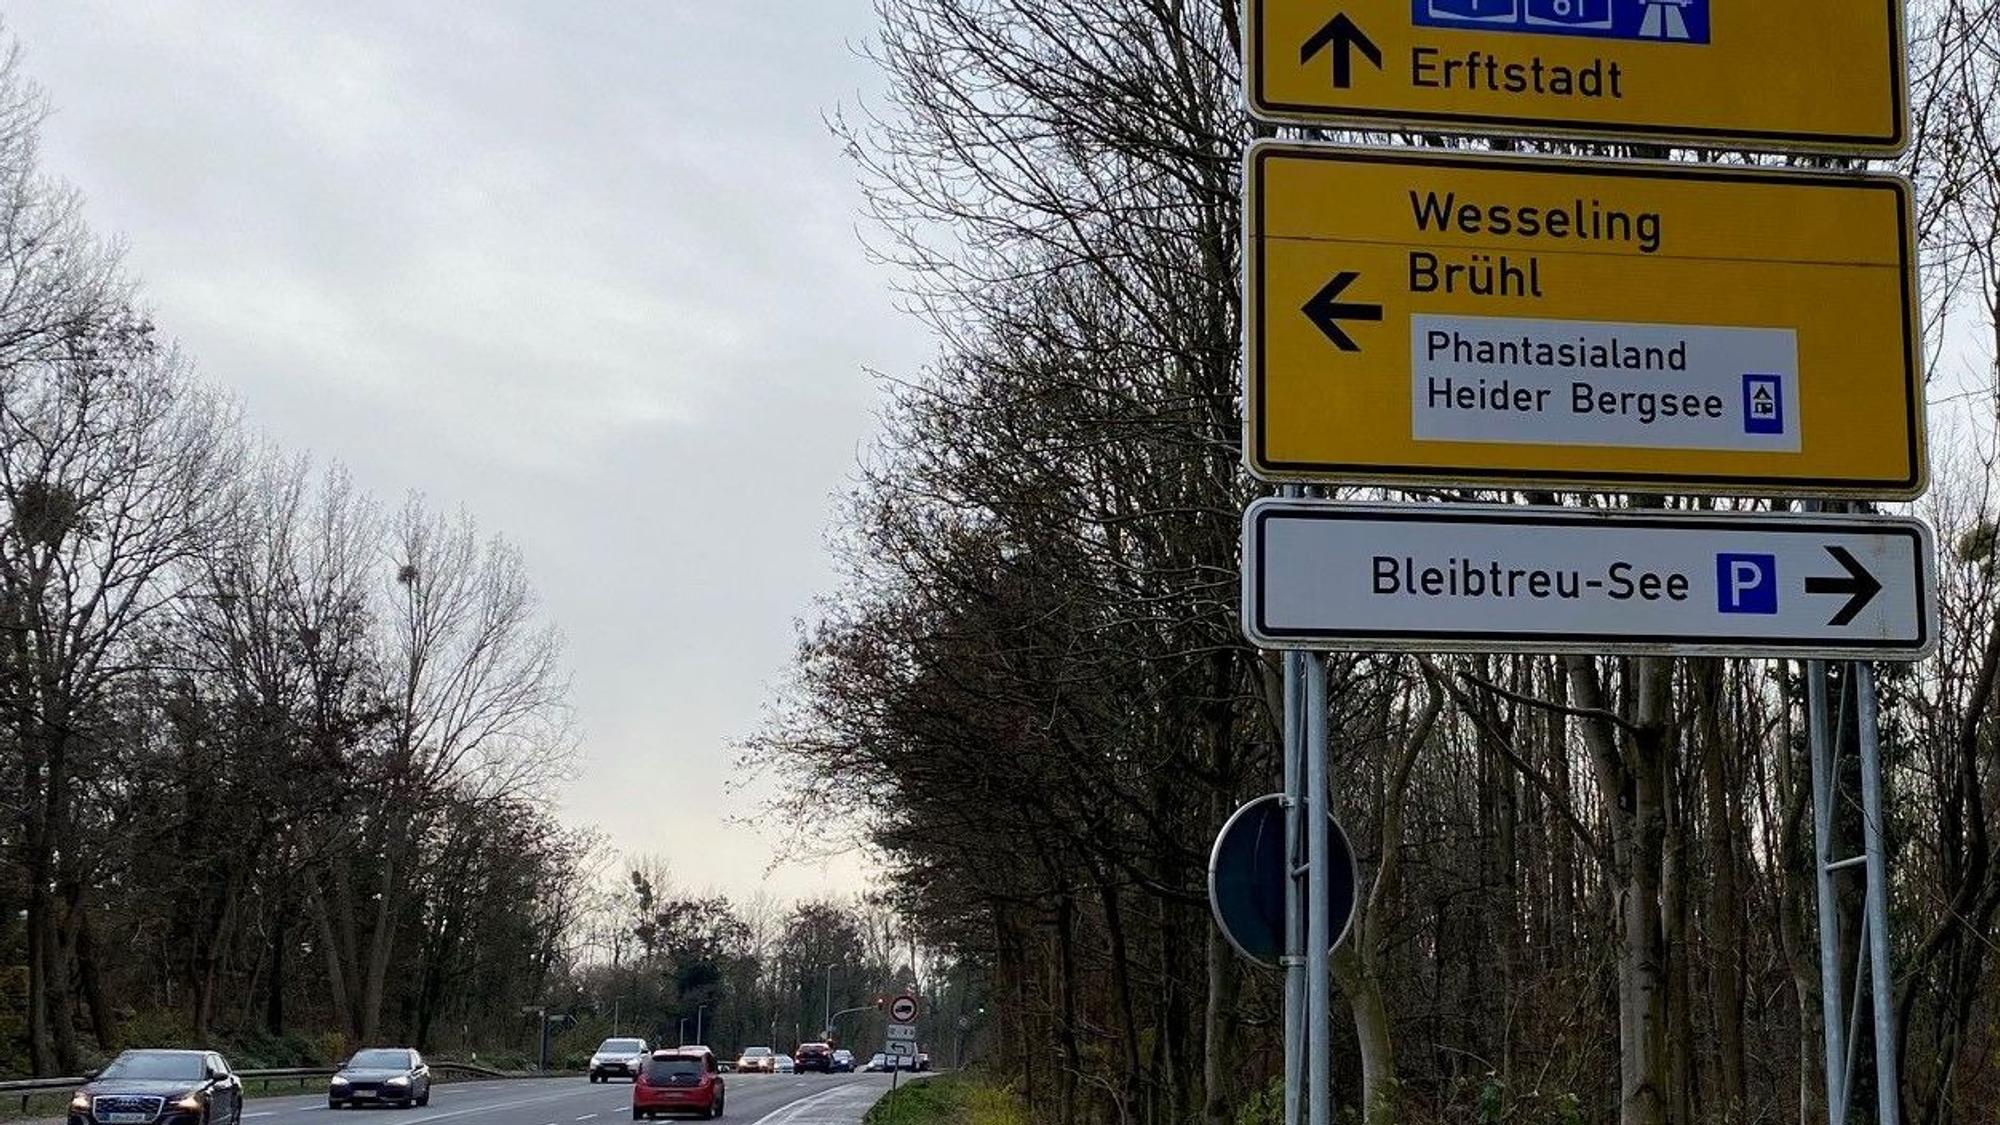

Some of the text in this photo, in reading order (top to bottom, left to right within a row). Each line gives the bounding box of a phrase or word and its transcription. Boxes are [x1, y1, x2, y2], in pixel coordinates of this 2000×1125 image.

[1412, 47, 1622, 99] Erftstadt
[1409, 190, 1660, 254] Wesseling
[1409, 251, 1542, 298] Brühl
[1427, 330, 1686, 372] Phantasialand
[1428, 376, 1723, 425] Heider Bergsee
[1372, 556, 1762, 606] Bleibtreu-See P
